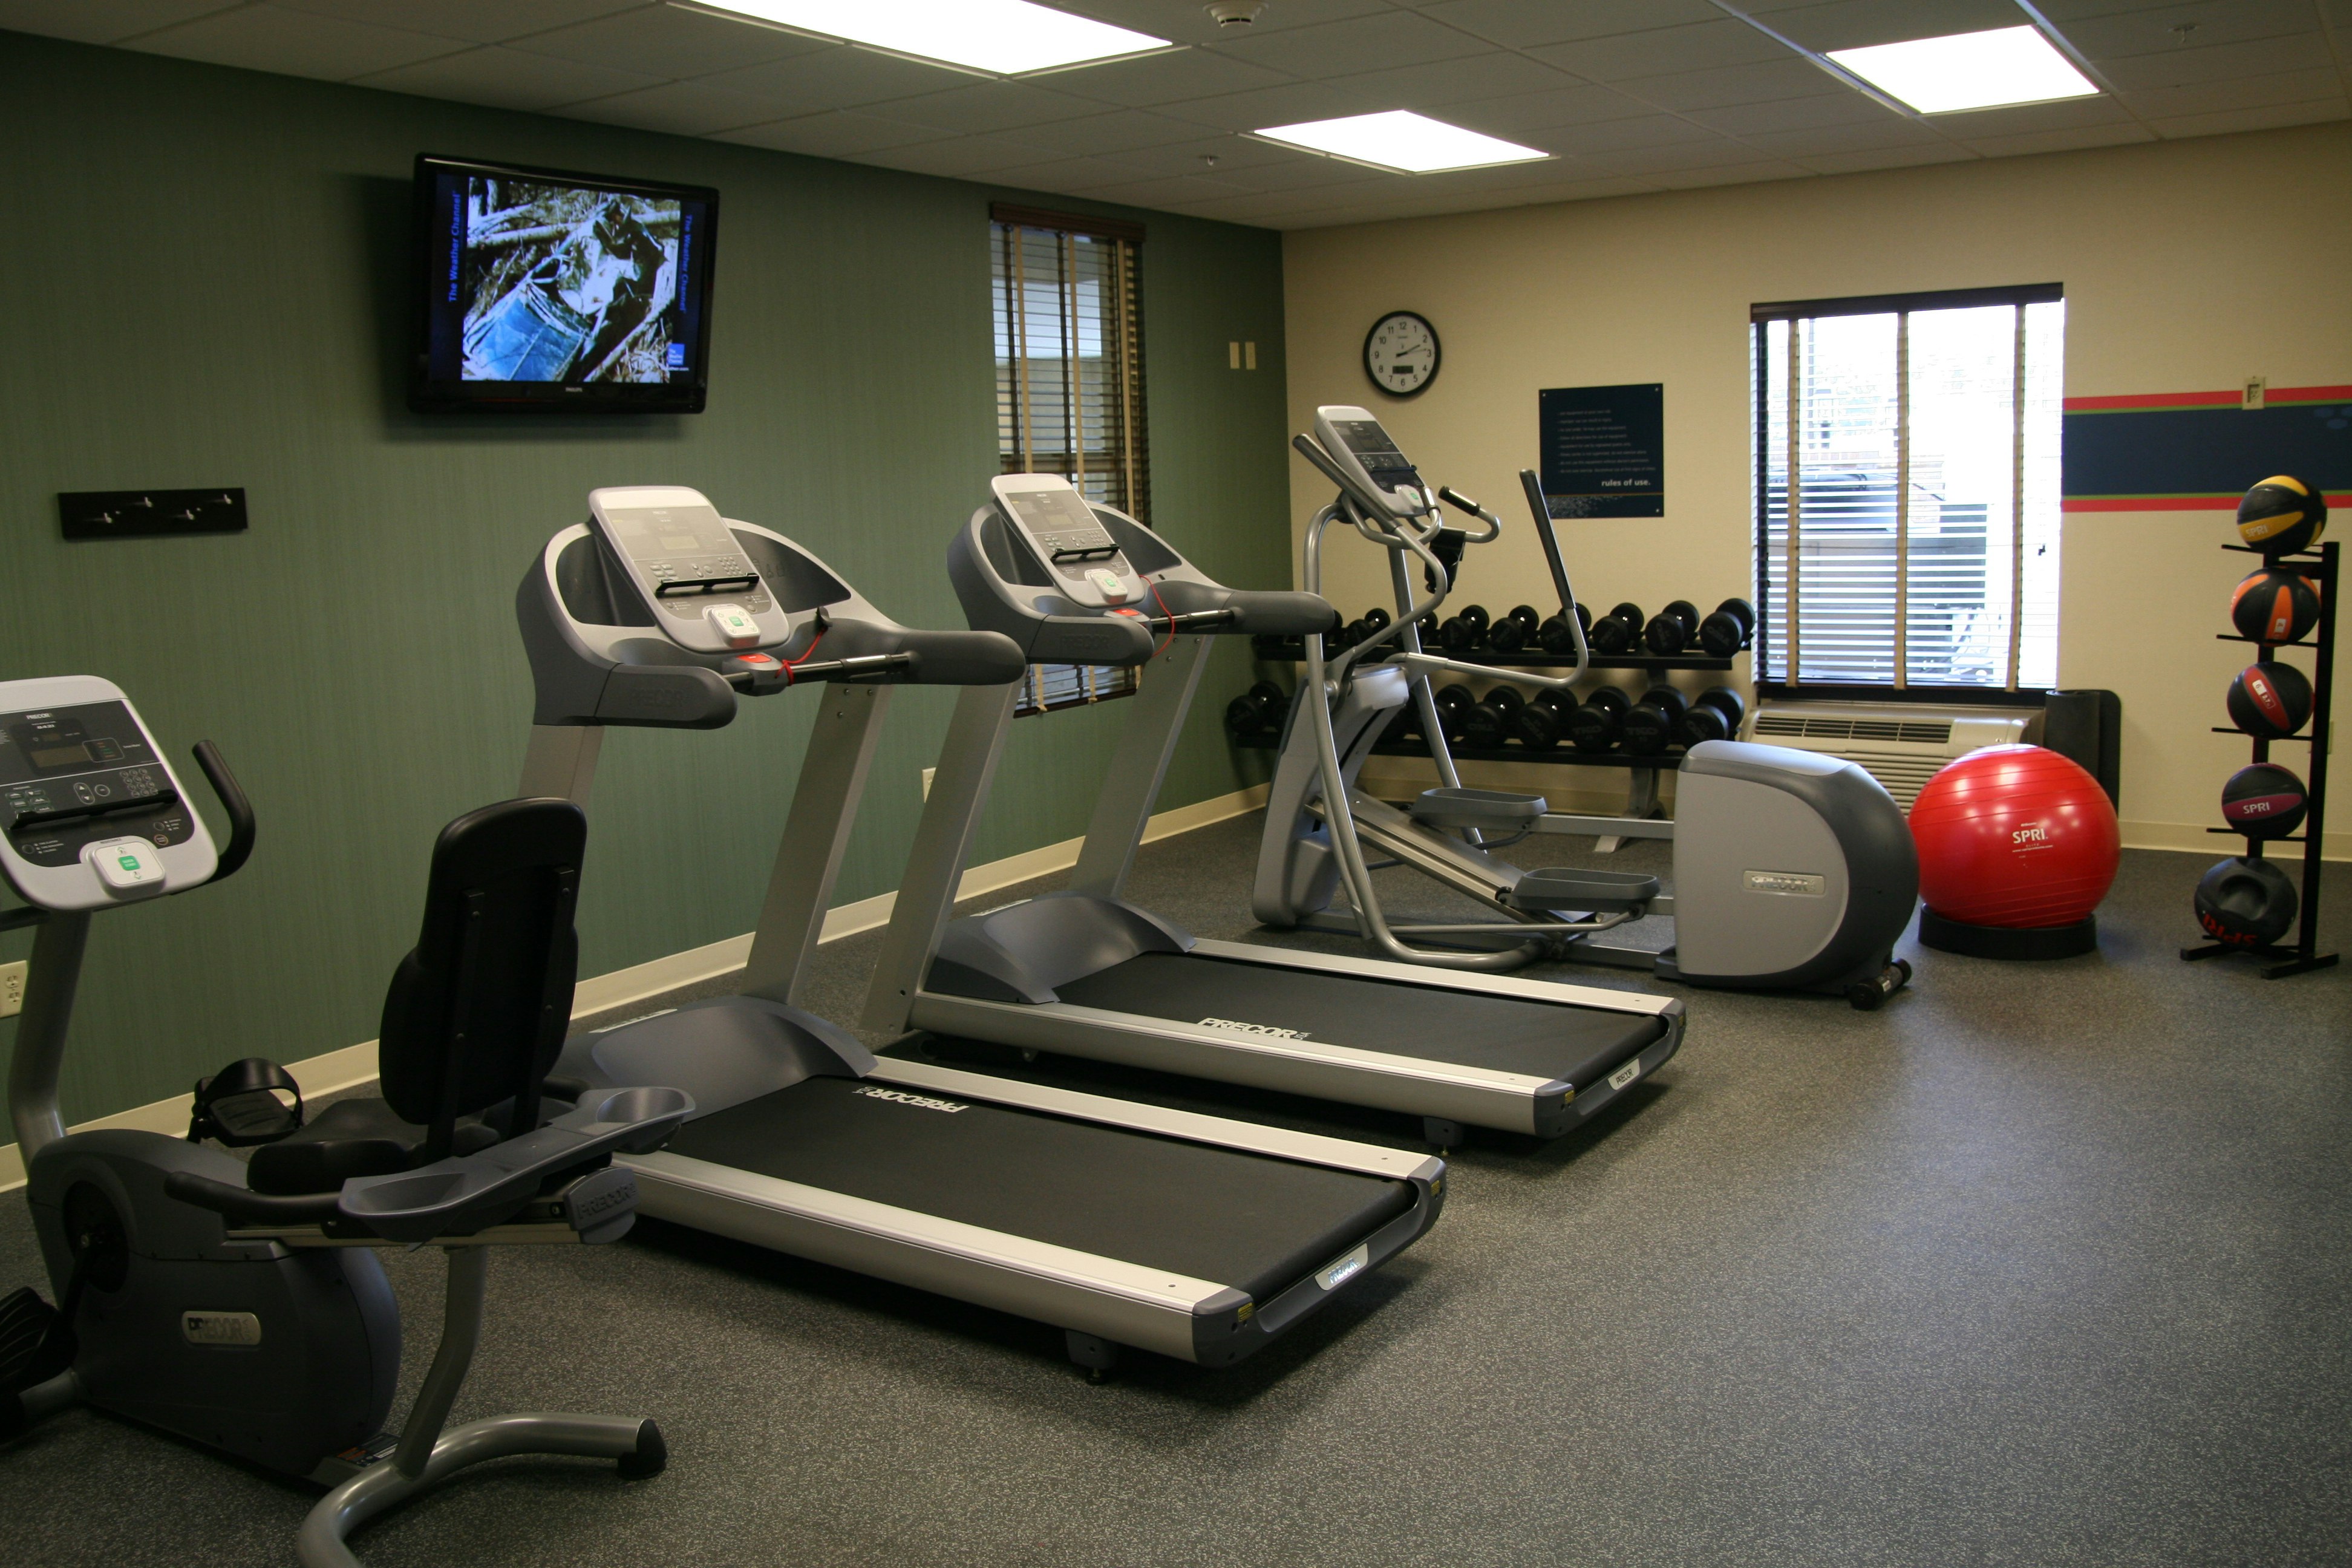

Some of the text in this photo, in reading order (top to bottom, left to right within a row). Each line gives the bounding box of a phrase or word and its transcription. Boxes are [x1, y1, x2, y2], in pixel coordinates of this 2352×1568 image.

[449, 239, 460, 280] Weather
[681, 231, 691, 266] Weather
[448, 283, 458, 302] The
[2243, 802, 2270, 814] SPRI
[2012, 828, 2046, 844] SPRI
[1197, 1017, 1298, 1039] PRECOR
[1616, 1068, 1633, 1085] PRECOR
[866, 1088, 970, 1113] PRECOR
[577, 1184, 630, 1220] PRECOR
[187, 1316, 243, 1341] PRECOR
